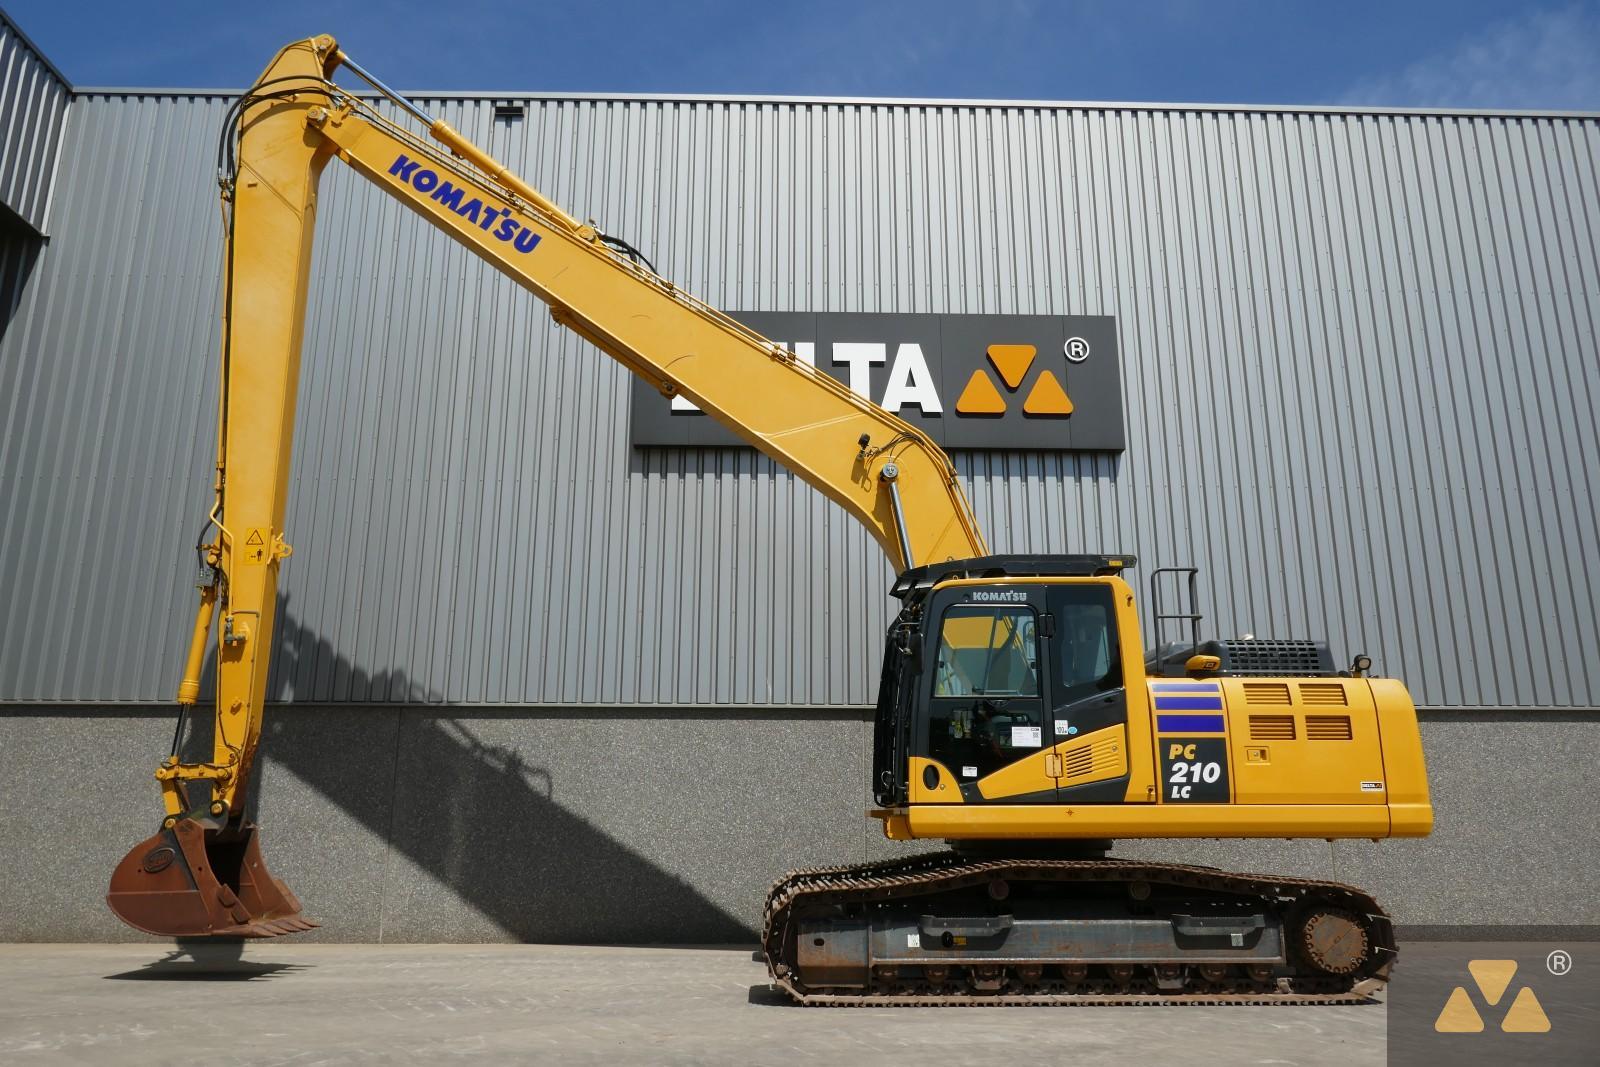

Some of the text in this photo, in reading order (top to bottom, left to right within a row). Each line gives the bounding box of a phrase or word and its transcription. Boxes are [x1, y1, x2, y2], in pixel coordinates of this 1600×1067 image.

[388, 154, 542, 254] KOMATSU
[973, 590, 1027, 601] KOMATSU
[1169, 744, 1197, 760] PC
[1169, 762, 1221, 783] 210
[1171, 785, 1192, 799] LC
